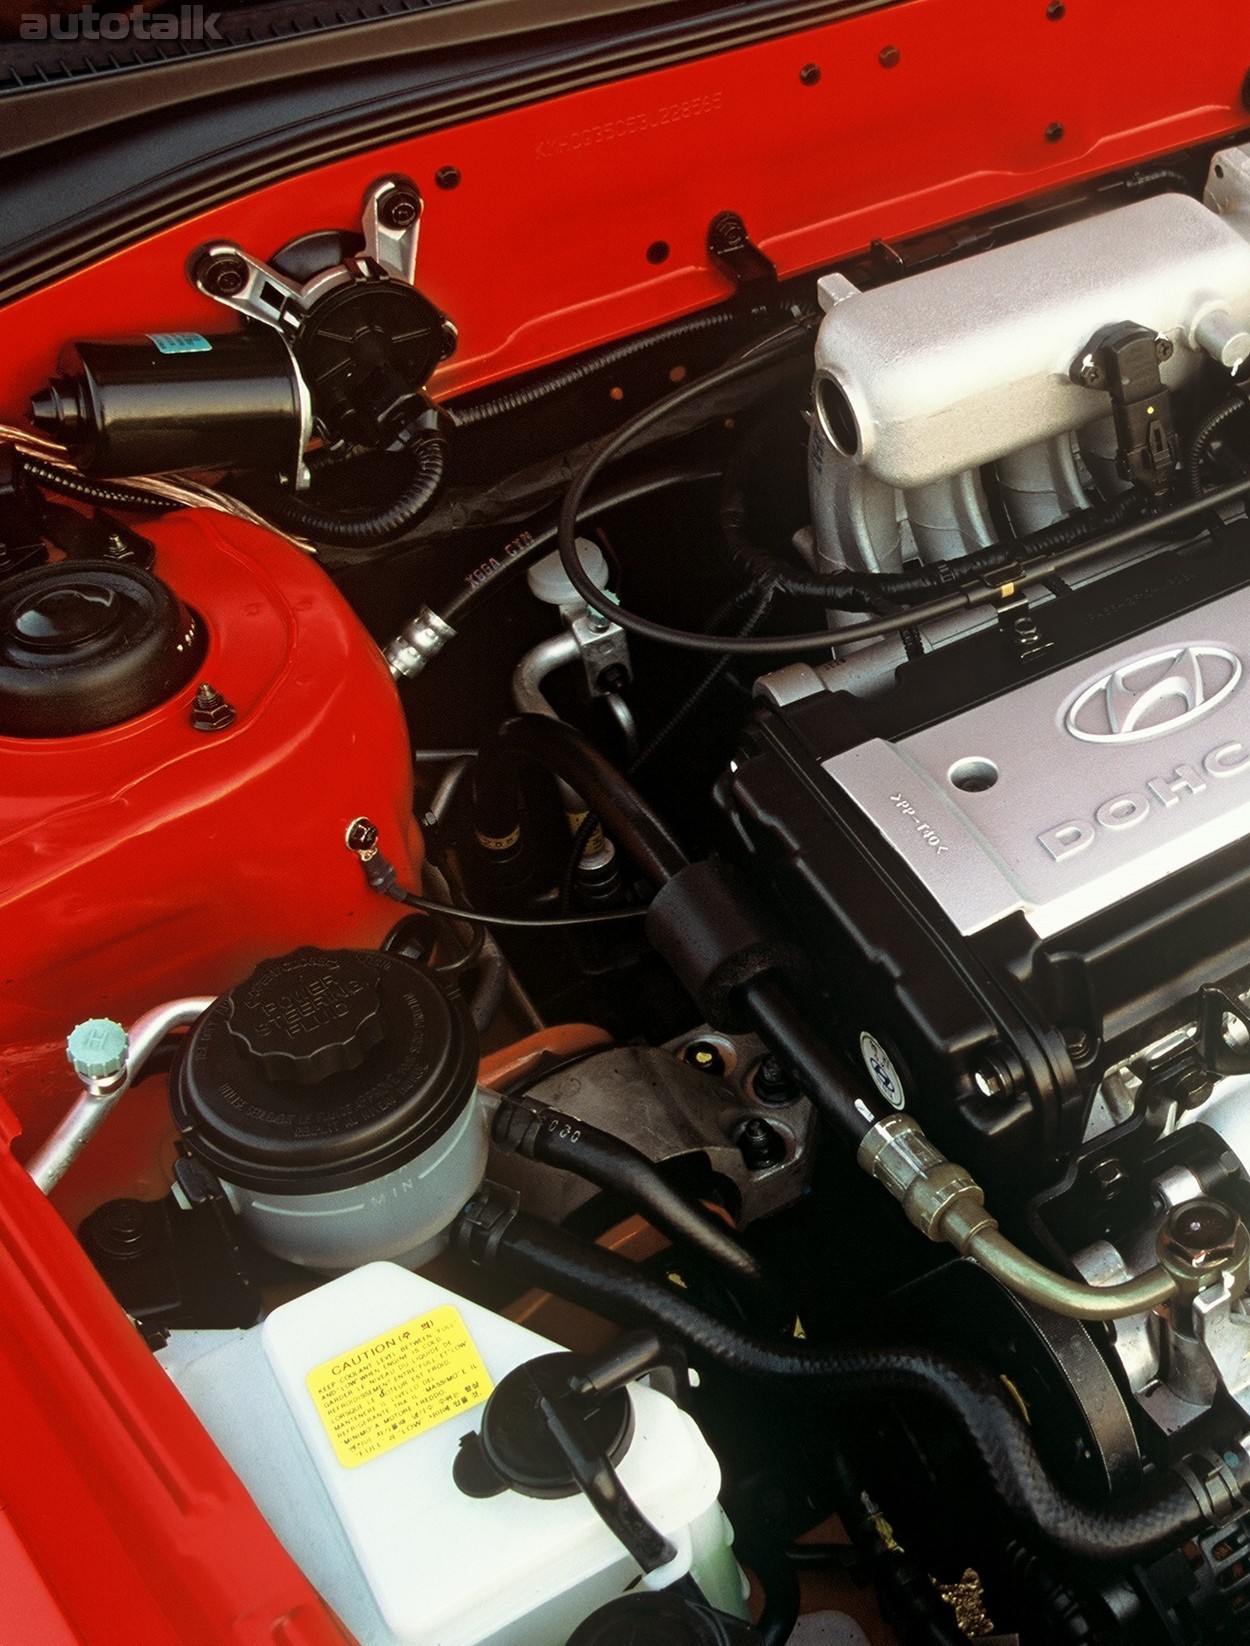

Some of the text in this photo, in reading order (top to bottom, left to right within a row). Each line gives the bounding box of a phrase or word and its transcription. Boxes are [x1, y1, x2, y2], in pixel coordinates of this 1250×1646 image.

[255, 978, 364, 1038] STEERING
[261, 973, 338, 1017] POWER
[285, 1001, 350, 1040] FLUID
[317, 1380, 337, 1394] KEEP
[338, 1362, 372, 1383] COOLANT
[399, 1332, 432, 1352] BETWEEN
[330, 1337, 396, 1376] CAUTION
[382, 1353, 408, 1369] ENGINE
[322, 1389, 353, 1408] GARDER
[368, 1368, 395, 1385] NIVEAU
[382, 1405, 412, 1424] MOTORE
